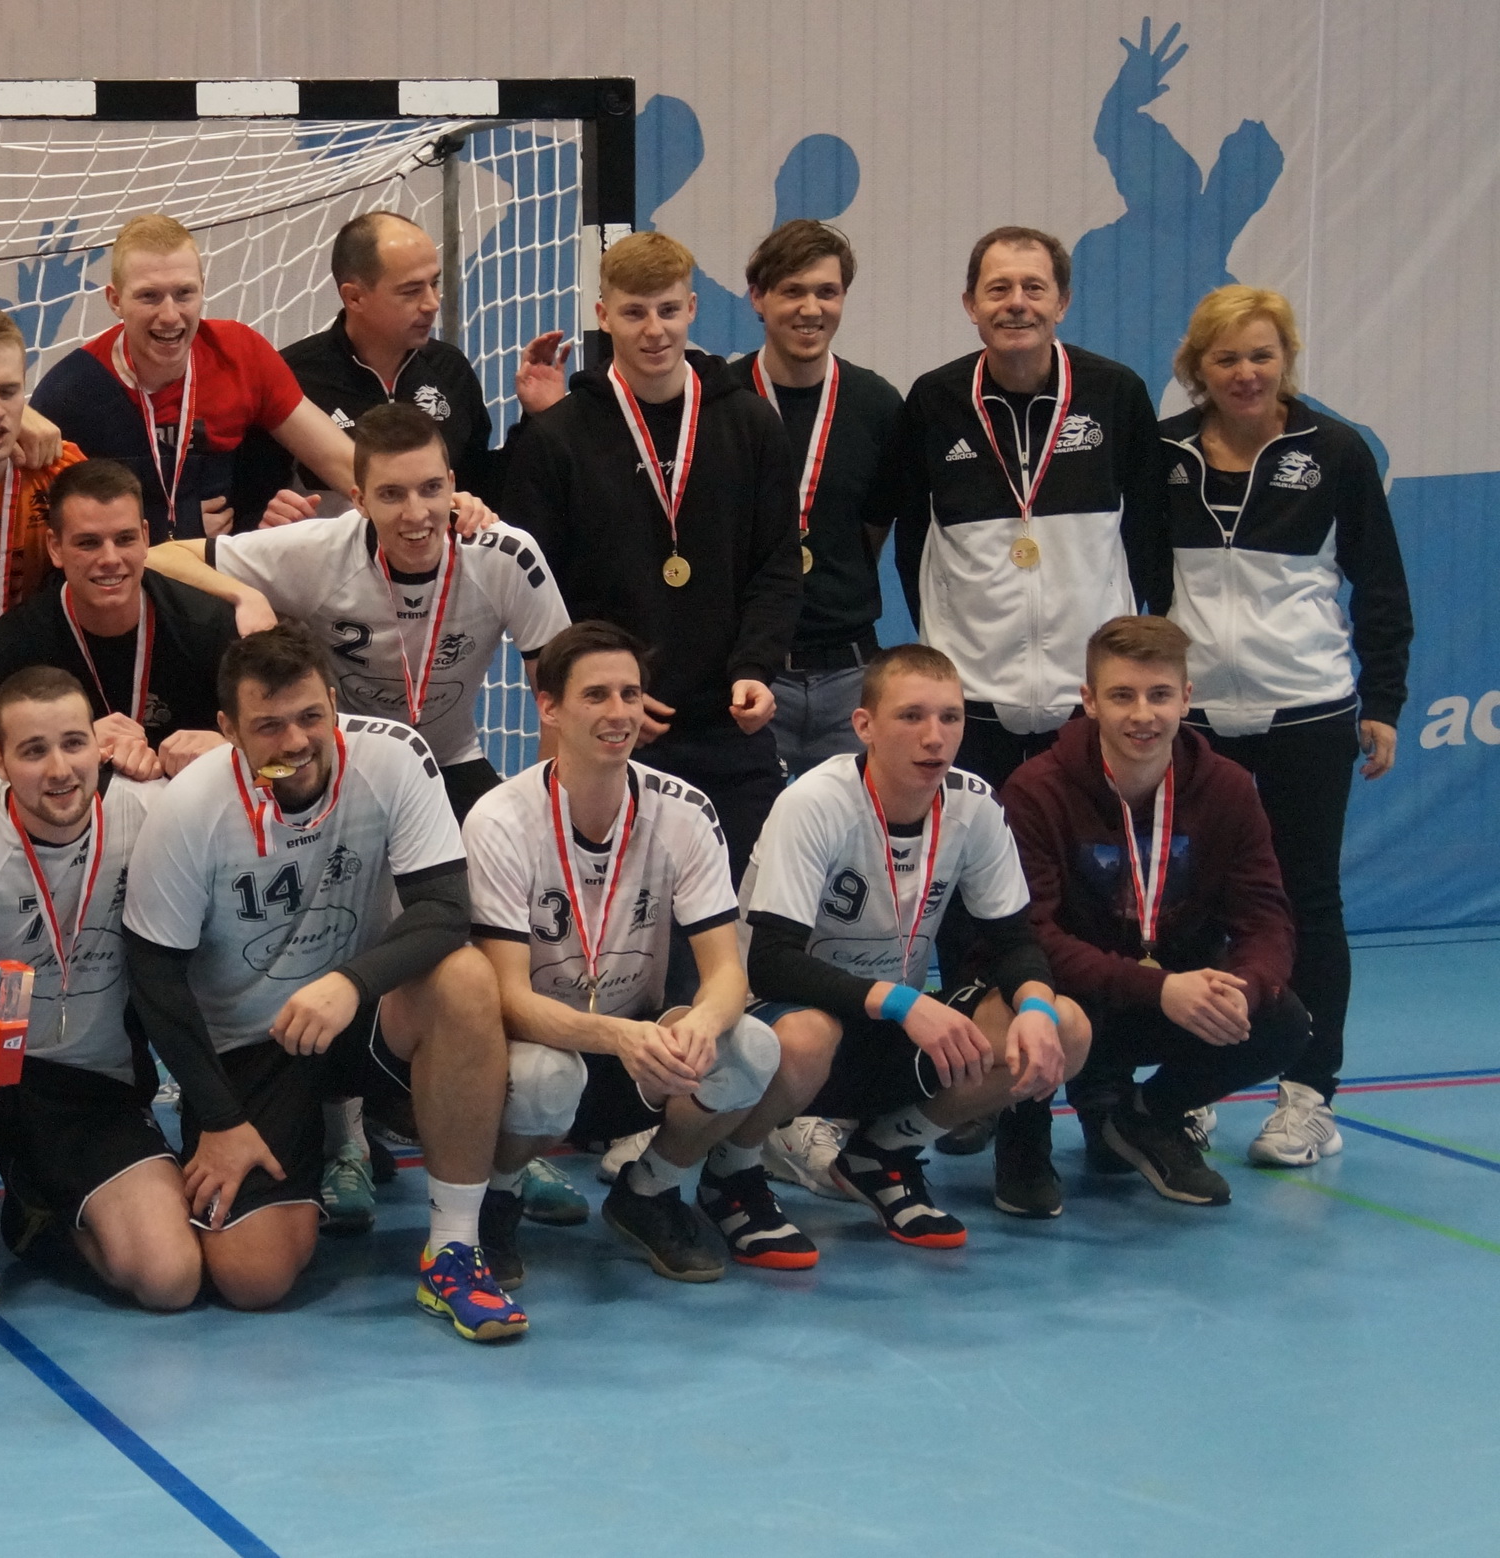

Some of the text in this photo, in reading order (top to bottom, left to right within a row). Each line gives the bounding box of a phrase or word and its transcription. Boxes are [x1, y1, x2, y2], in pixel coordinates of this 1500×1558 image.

[945, 453, 977, 462] adidas
[331, 619, 374, 668] 2
[286, 831, 322, 849] erima
[232, 861, 304, 922] 14
[532, 888, 573, 945] 3
[821, 867, 870, 925] 9
[18, 892, 55, 945] 7
